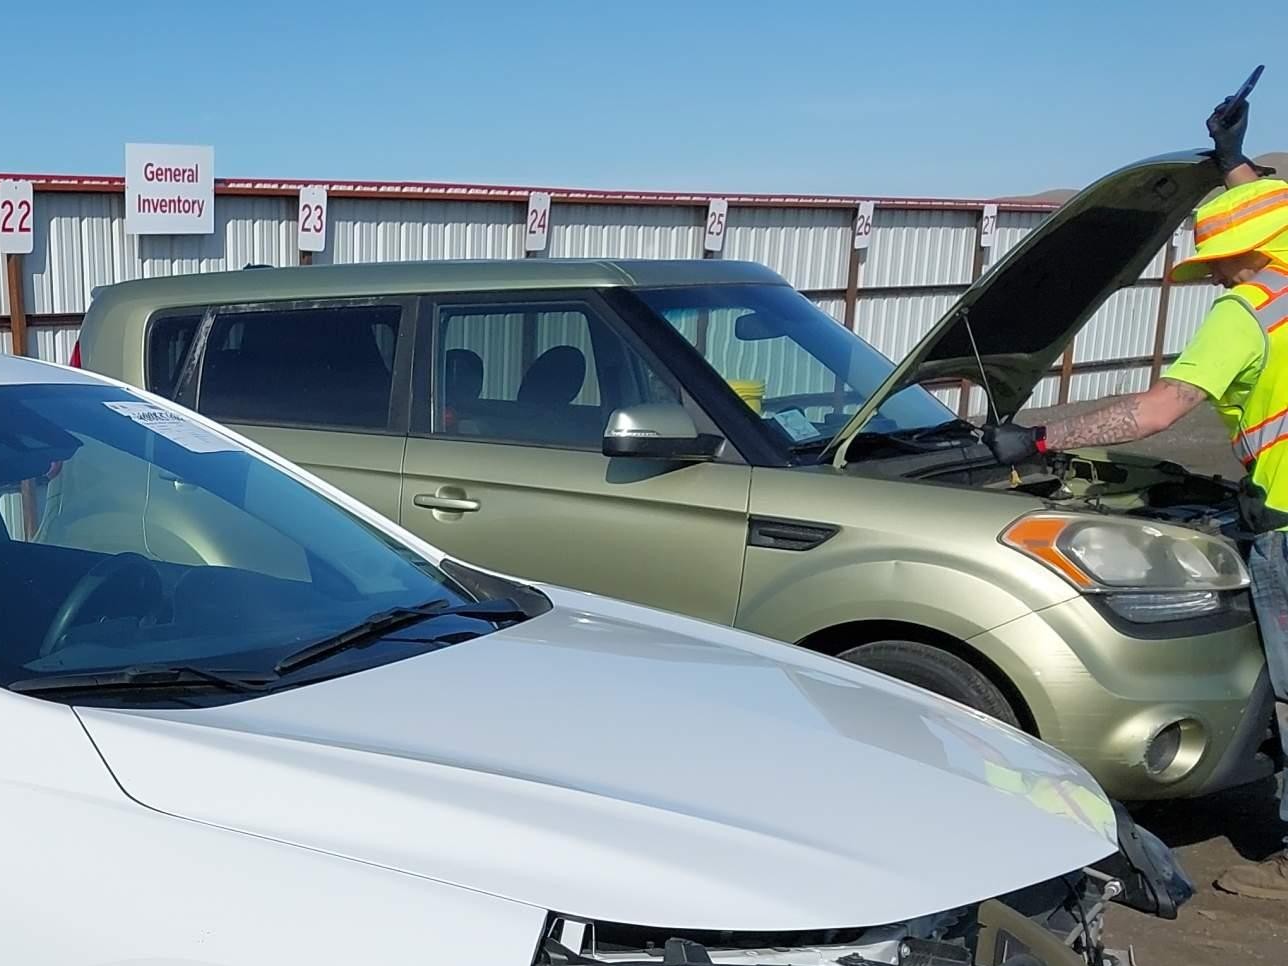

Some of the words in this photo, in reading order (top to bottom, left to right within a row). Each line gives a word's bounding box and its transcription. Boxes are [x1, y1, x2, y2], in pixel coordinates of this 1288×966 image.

[144, 162, 199, 183] General
[1, 200, 31, 233] 22
[137, 194, 205, 218] Inventory
[301, 204, 323, 233] 23
[529, 209, 547, 234] 24
[708, 211, 724, 236] 25
[856, 214, 871, 236] 26
[982, 215, 996, 235] 27
